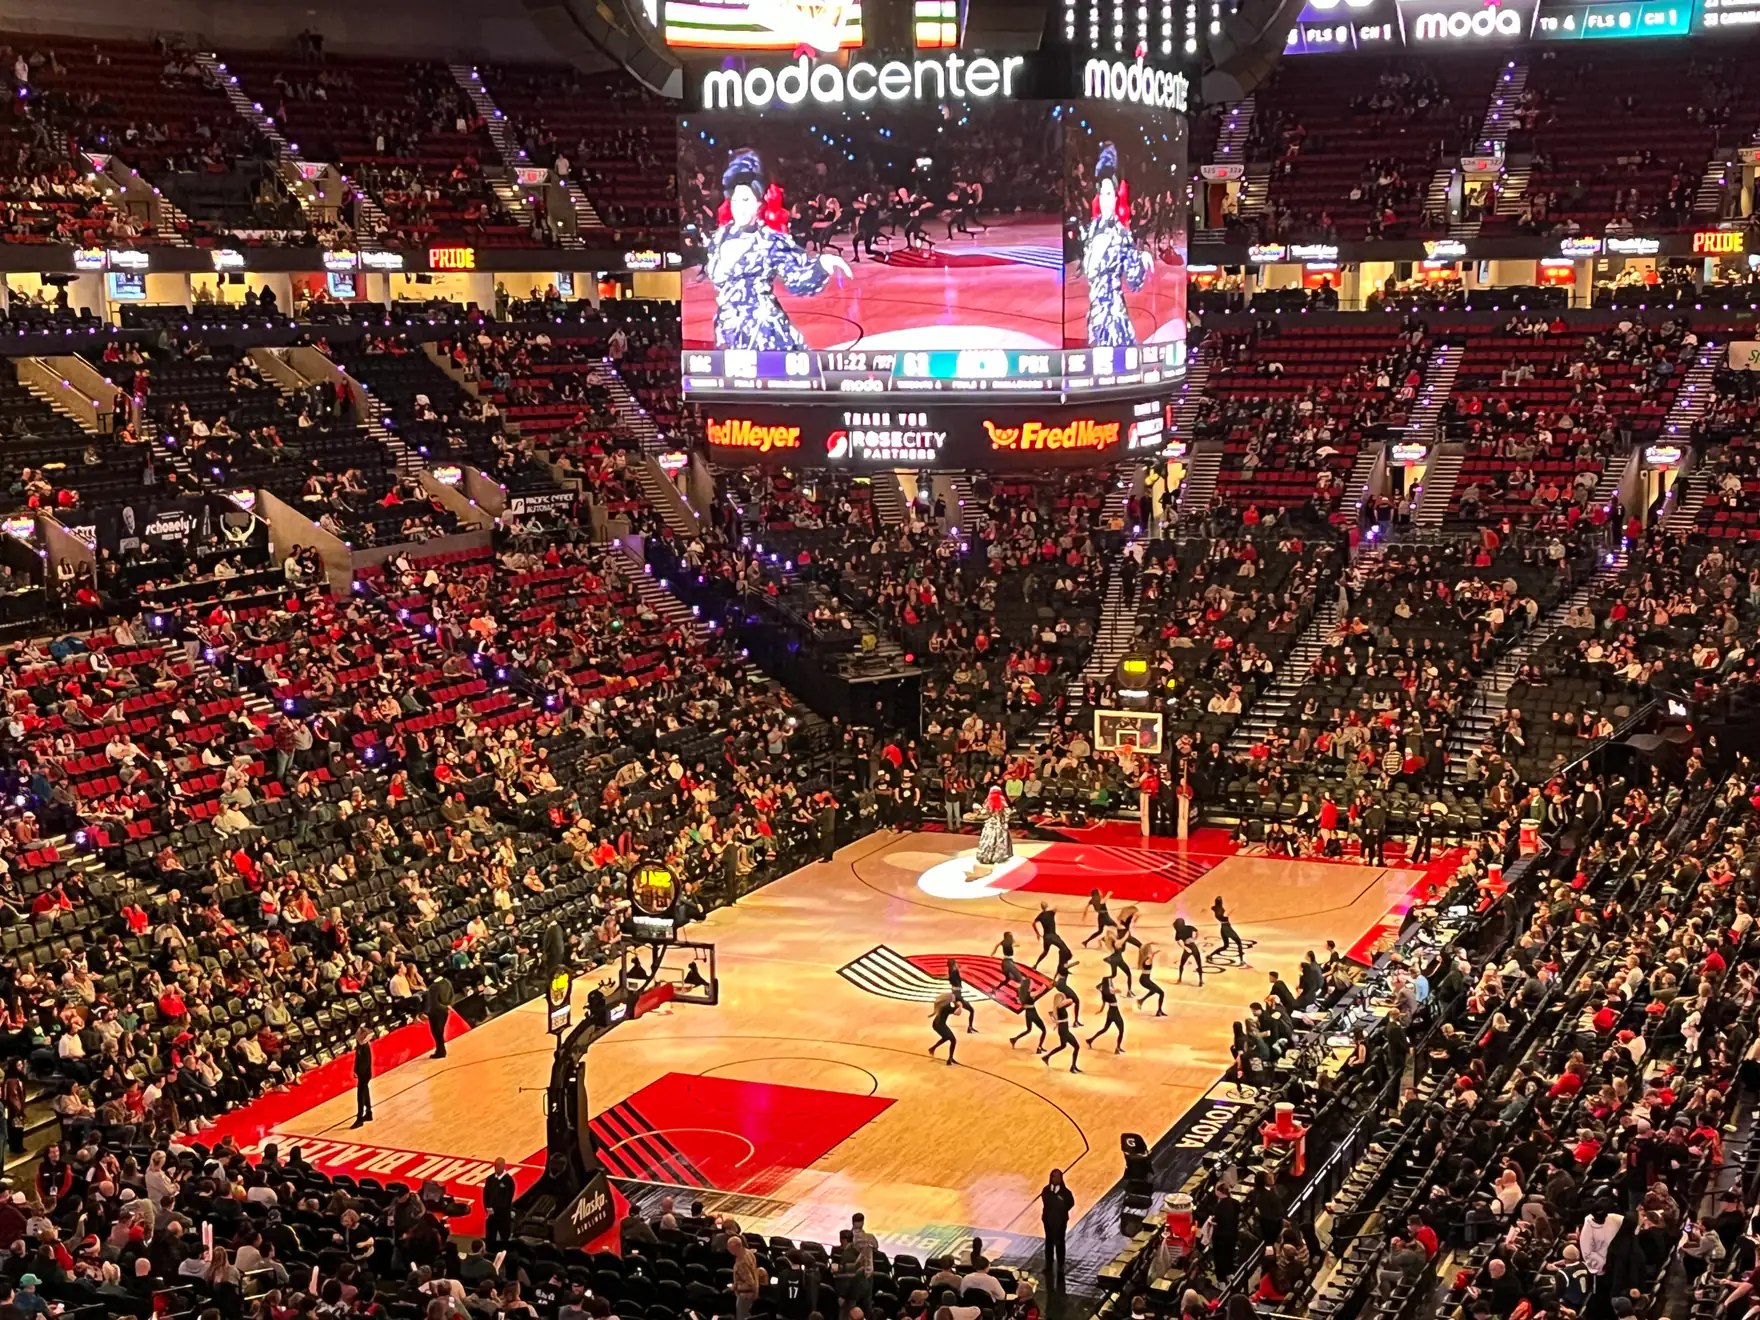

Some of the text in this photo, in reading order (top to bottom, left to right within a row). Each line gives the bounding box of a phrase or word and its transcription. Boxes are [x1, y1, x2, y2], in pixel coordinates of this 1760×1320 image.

[1416, 4, 1521, 38] moda
[1588, 15, 1615, 28] FLS
[1668, 9, 1677, 26] 1
[1306, 26, 1332, 42] FLS
[1384, 23, 1392, 41] 1
[1693, 232, 1744, 253] PRIDE
[429, 248, 475, 268] PRIDE
[827, 352, 867, 371] 11:22
[841, 376, 884, 392] moda
[863, 449, 936, 460] PARTNERS
[1175, 1105, 1241, 1148] TOYOTA
[570, 1190, 606, 1225] Alaska
[788, 1286, 799, 1299] 17
